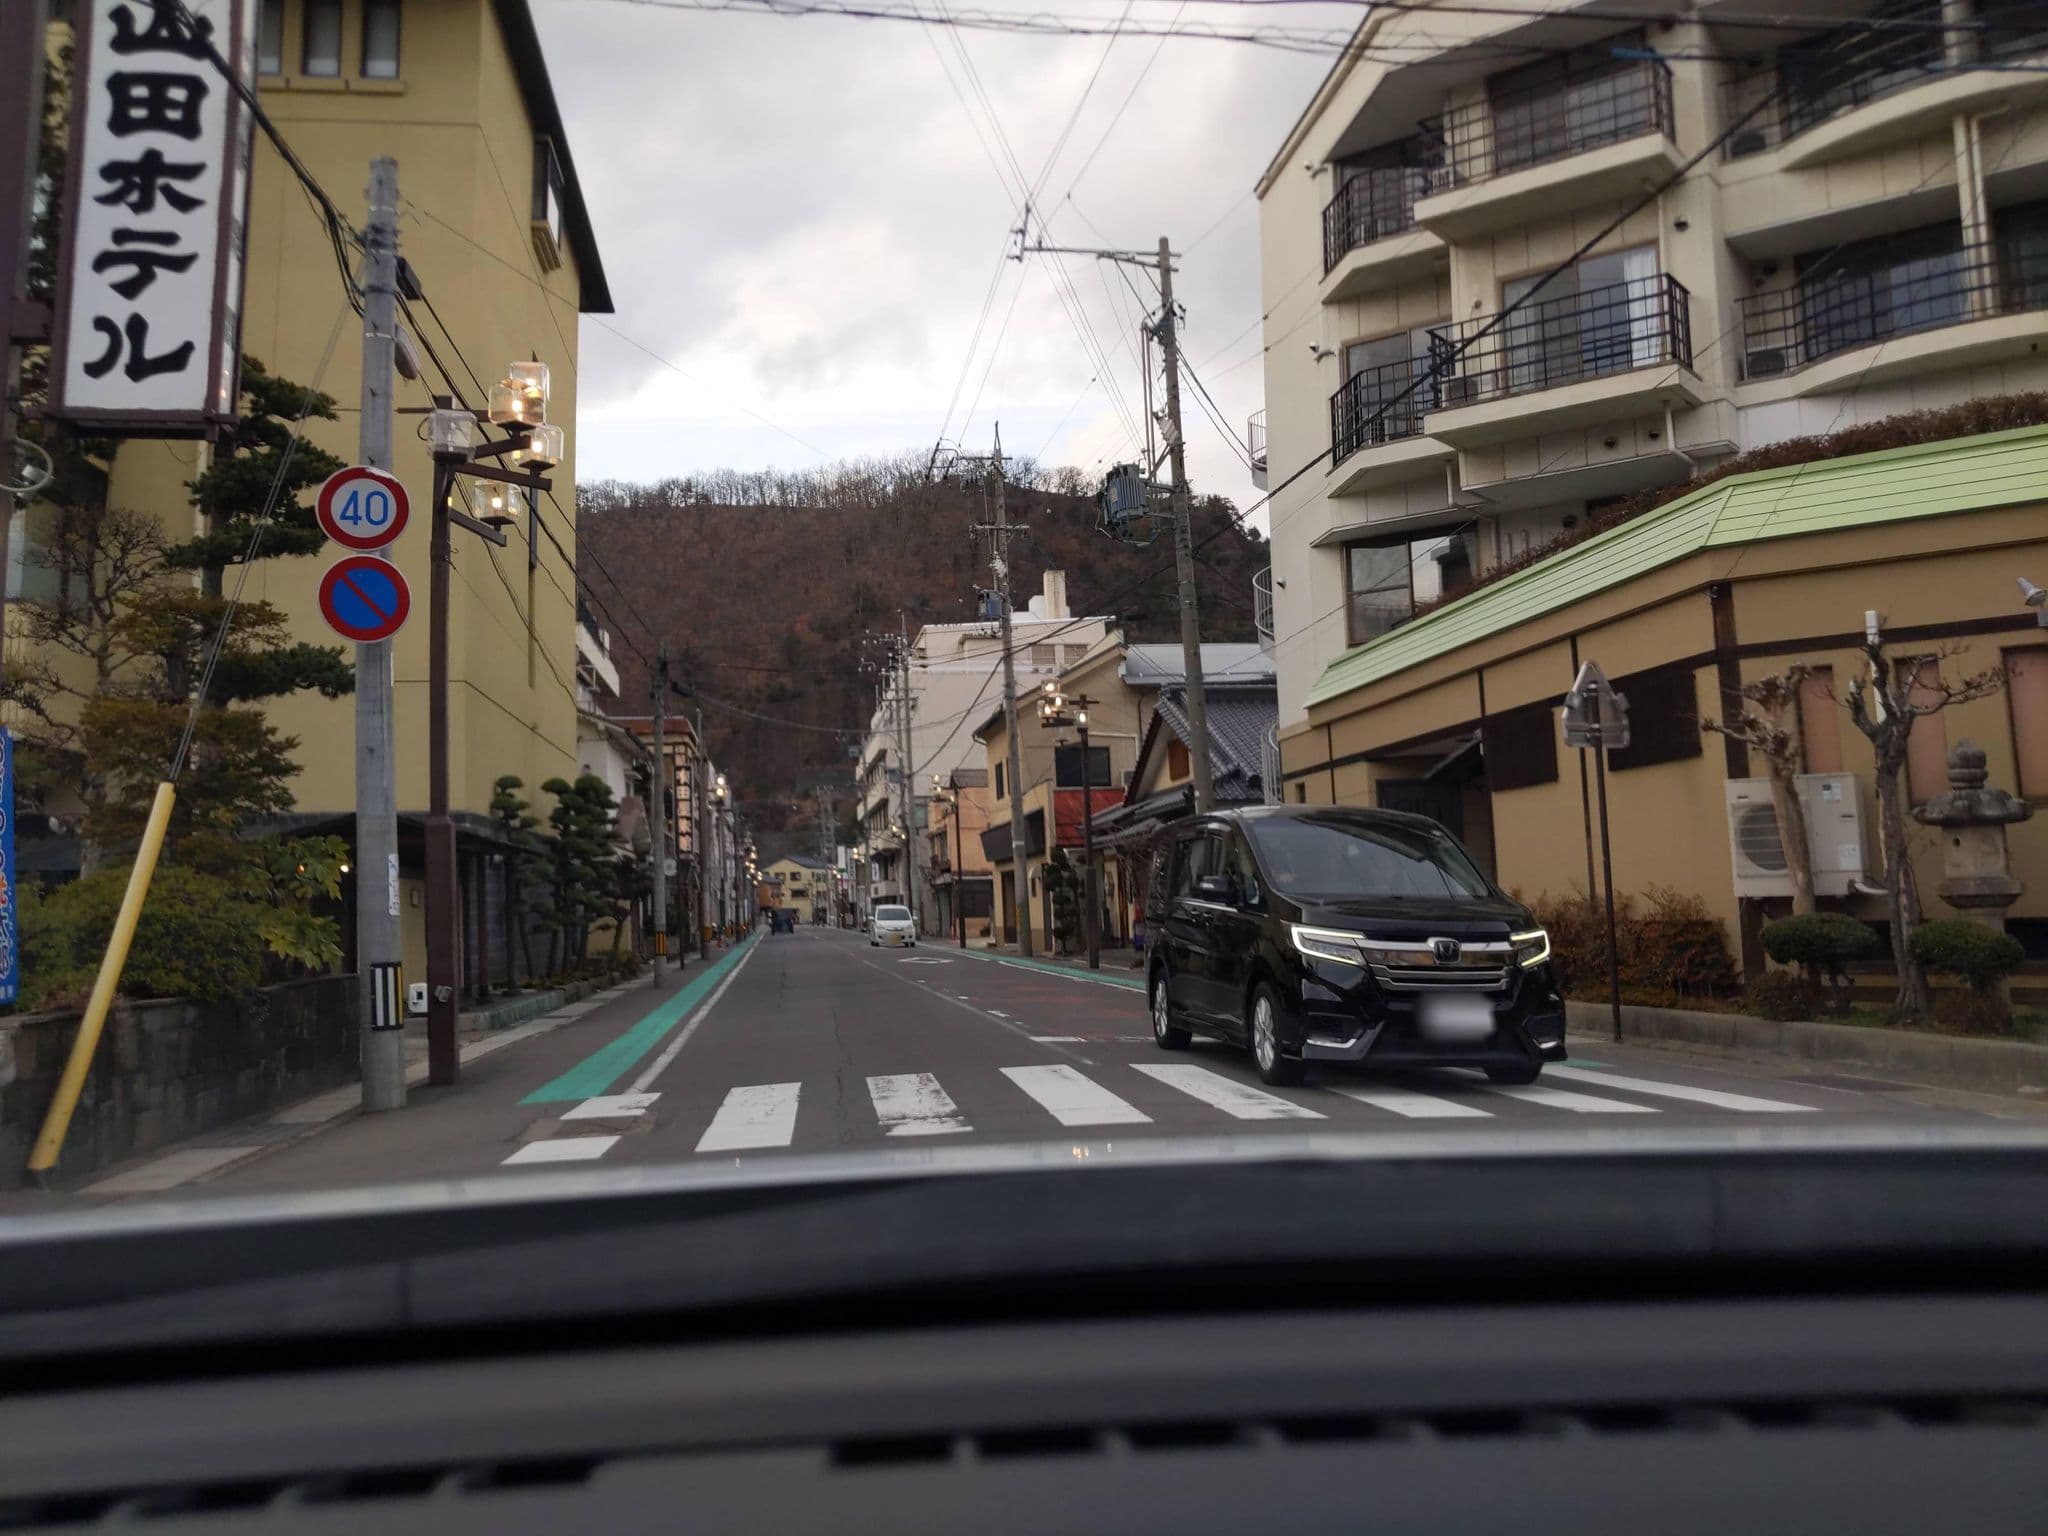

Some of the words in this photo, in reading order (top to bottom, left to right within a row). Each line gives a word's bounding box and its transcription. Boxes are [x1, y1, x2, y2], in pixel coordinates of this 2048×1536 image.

[84, 0, 213, 383] 山田ホテル
[340, 490, 388, 525] 40
